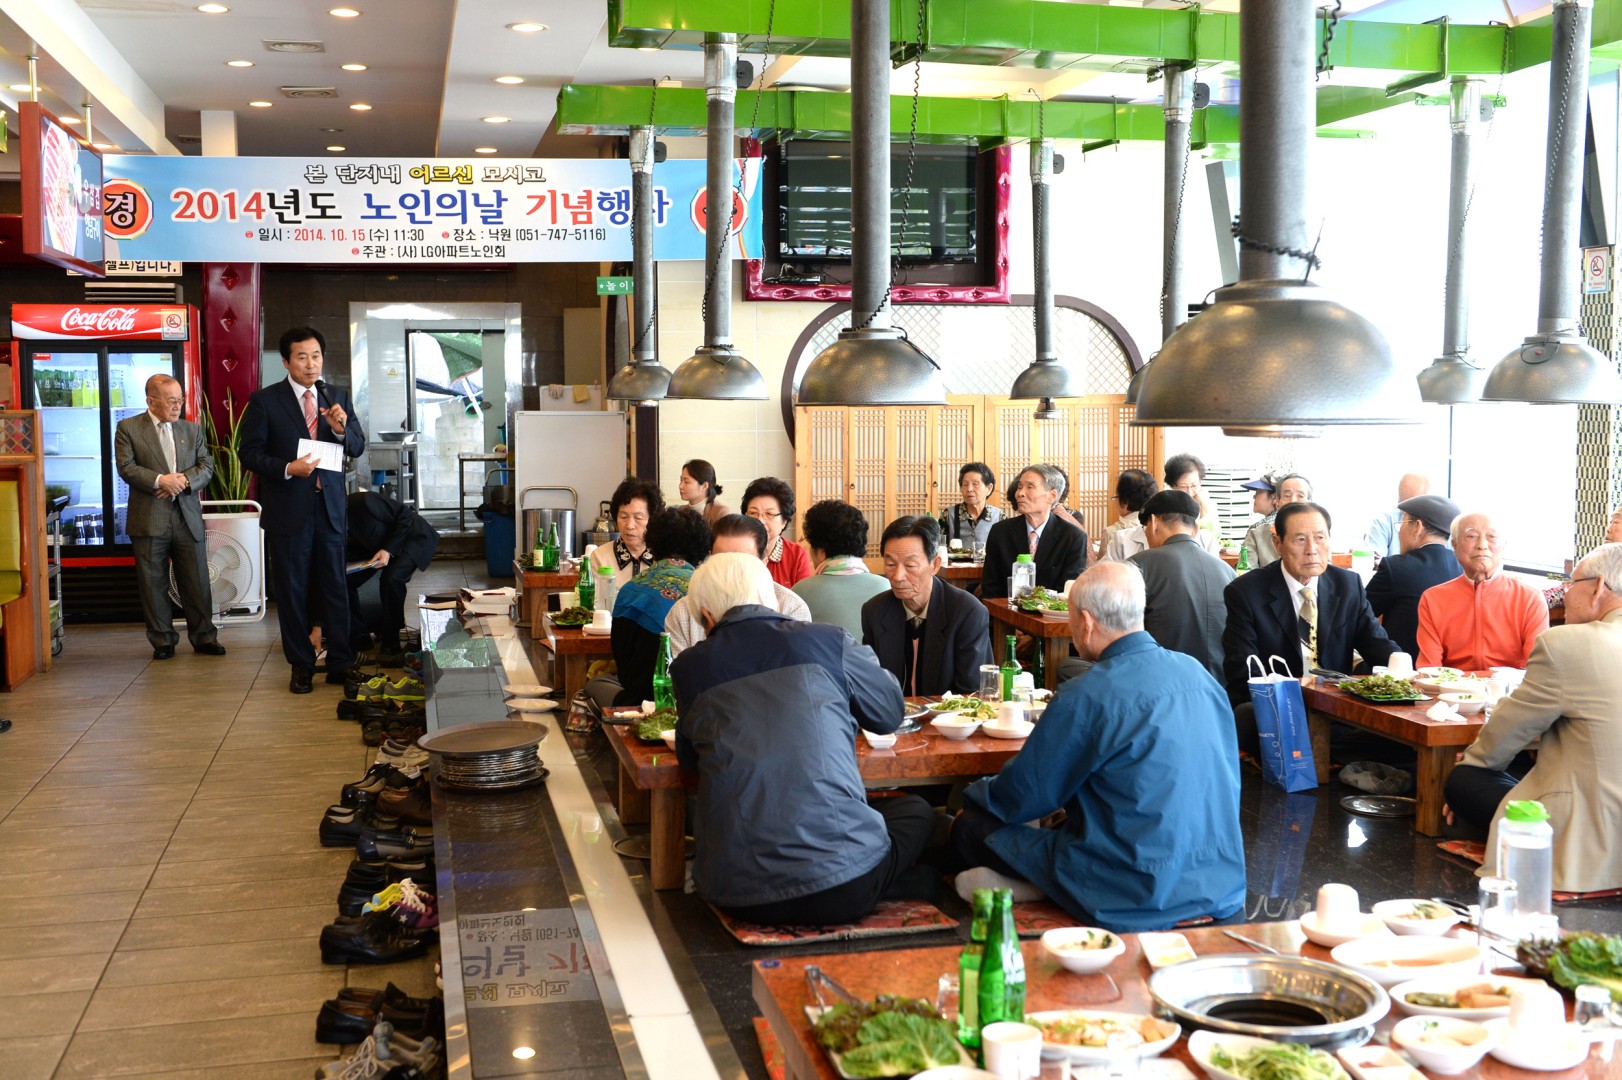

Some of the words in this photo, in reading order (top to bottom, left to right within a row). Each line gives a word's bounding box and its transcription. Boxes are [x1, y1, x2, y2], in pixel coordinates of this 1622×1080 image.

[304, 164, 328, 184] 본
[336, 164, 401, 184] 단지내
[409, 164, 474, 185] 어르신
[481, 164, 546, 185] 모시고
[104, 191, 137, 230] 경
[173, 188, 343, 225] 2014년도
[360, 189, 509, 225] 노인의날
[258, 228, 283, 242] 일시
[294, 228, 326, 242] 2014.
[352, 228, 366, 242] 15
[393, 228, 425, 242] 11:30
[453, 228, 475, 242] 장소
[487, 228, 511, 242] 낙원
[515, 228, 606, 242] (051-747-5116)
[363, 245, 387, 258] 주관
[421, 245, 506, 258] LG아파트노인회
[61, 307, 140, 331] Coca-Cola
